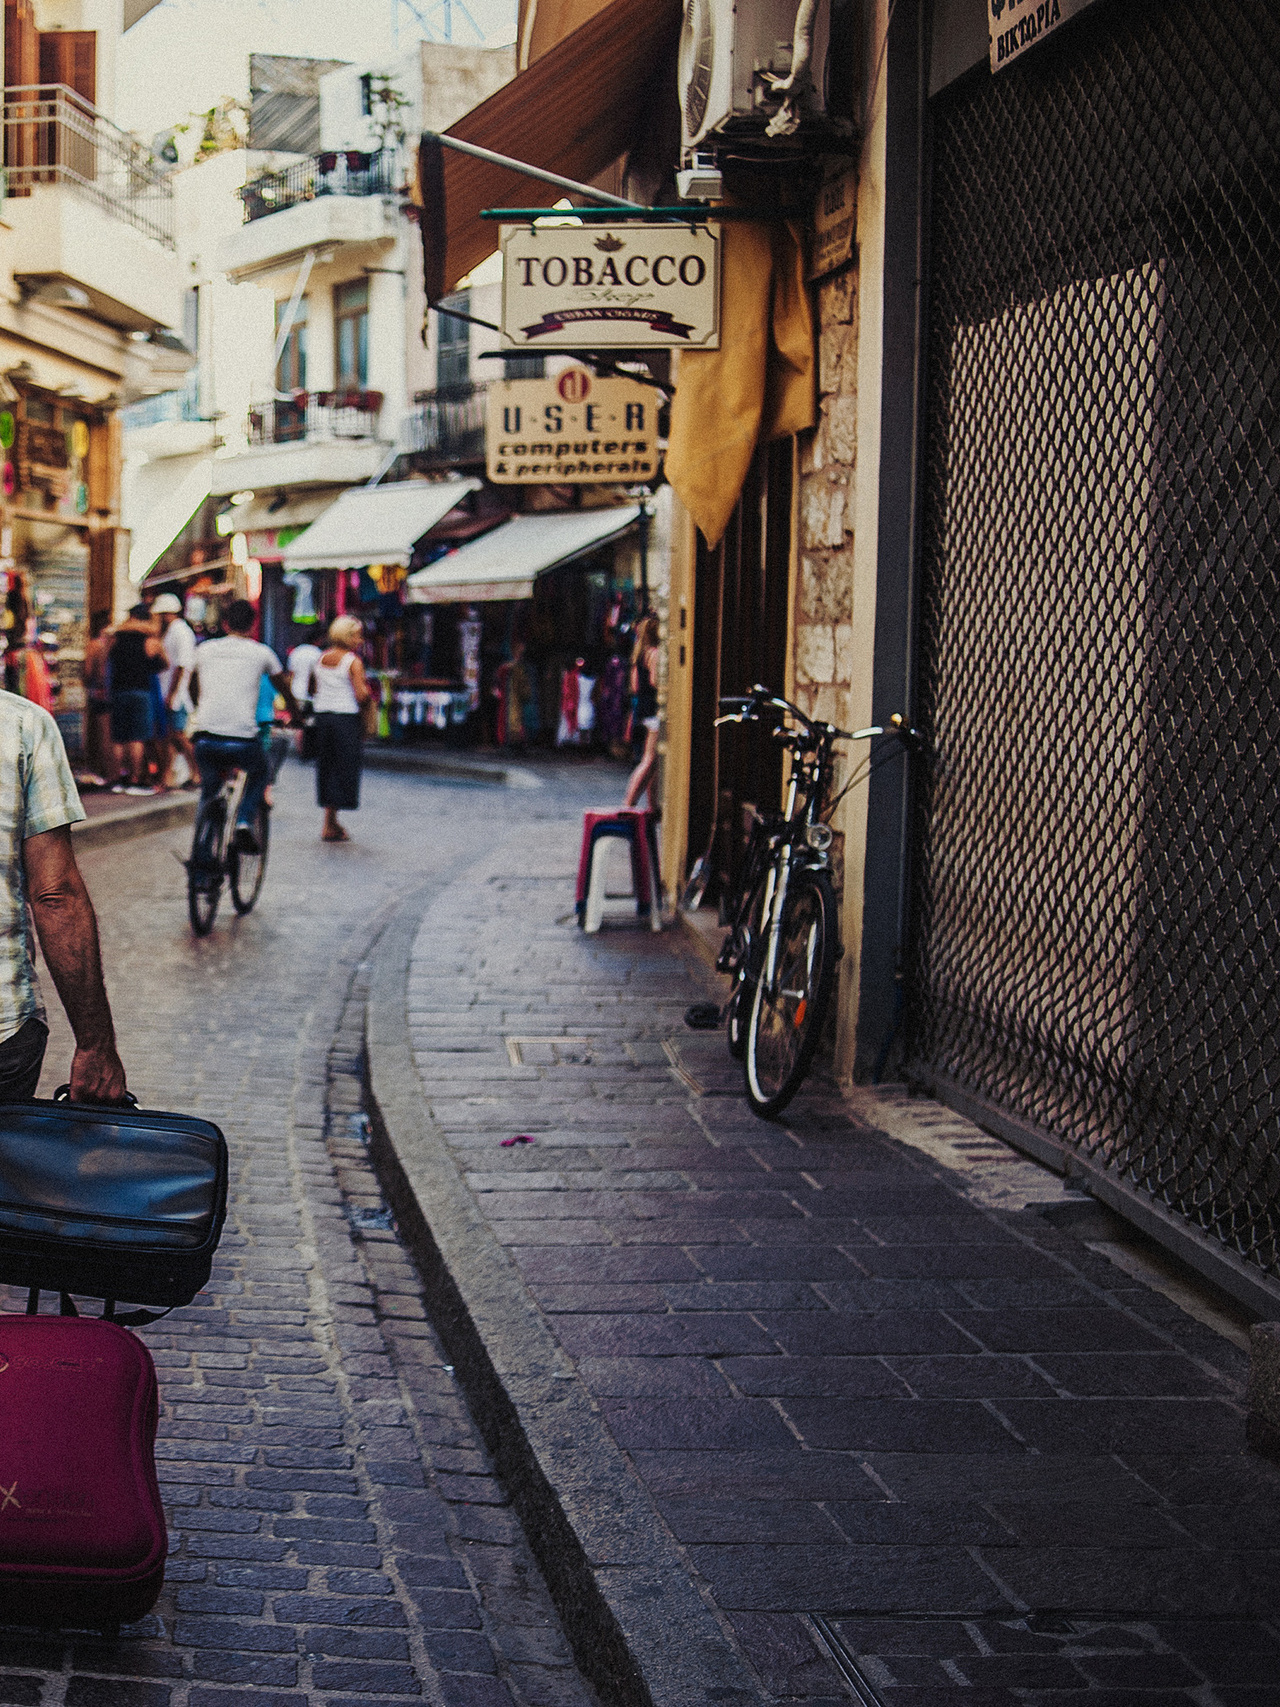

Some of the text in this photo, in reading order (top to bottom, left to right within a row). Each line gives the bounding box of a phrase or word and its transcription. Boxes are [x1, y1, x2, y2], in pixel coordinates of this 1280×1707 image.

[517, 255, 706, 286] TOBACCO
[605, 310, 659, 321] CIGARS
[498, 441, 647, 457] computers
[495, 460, 652, 476] & peripherals
